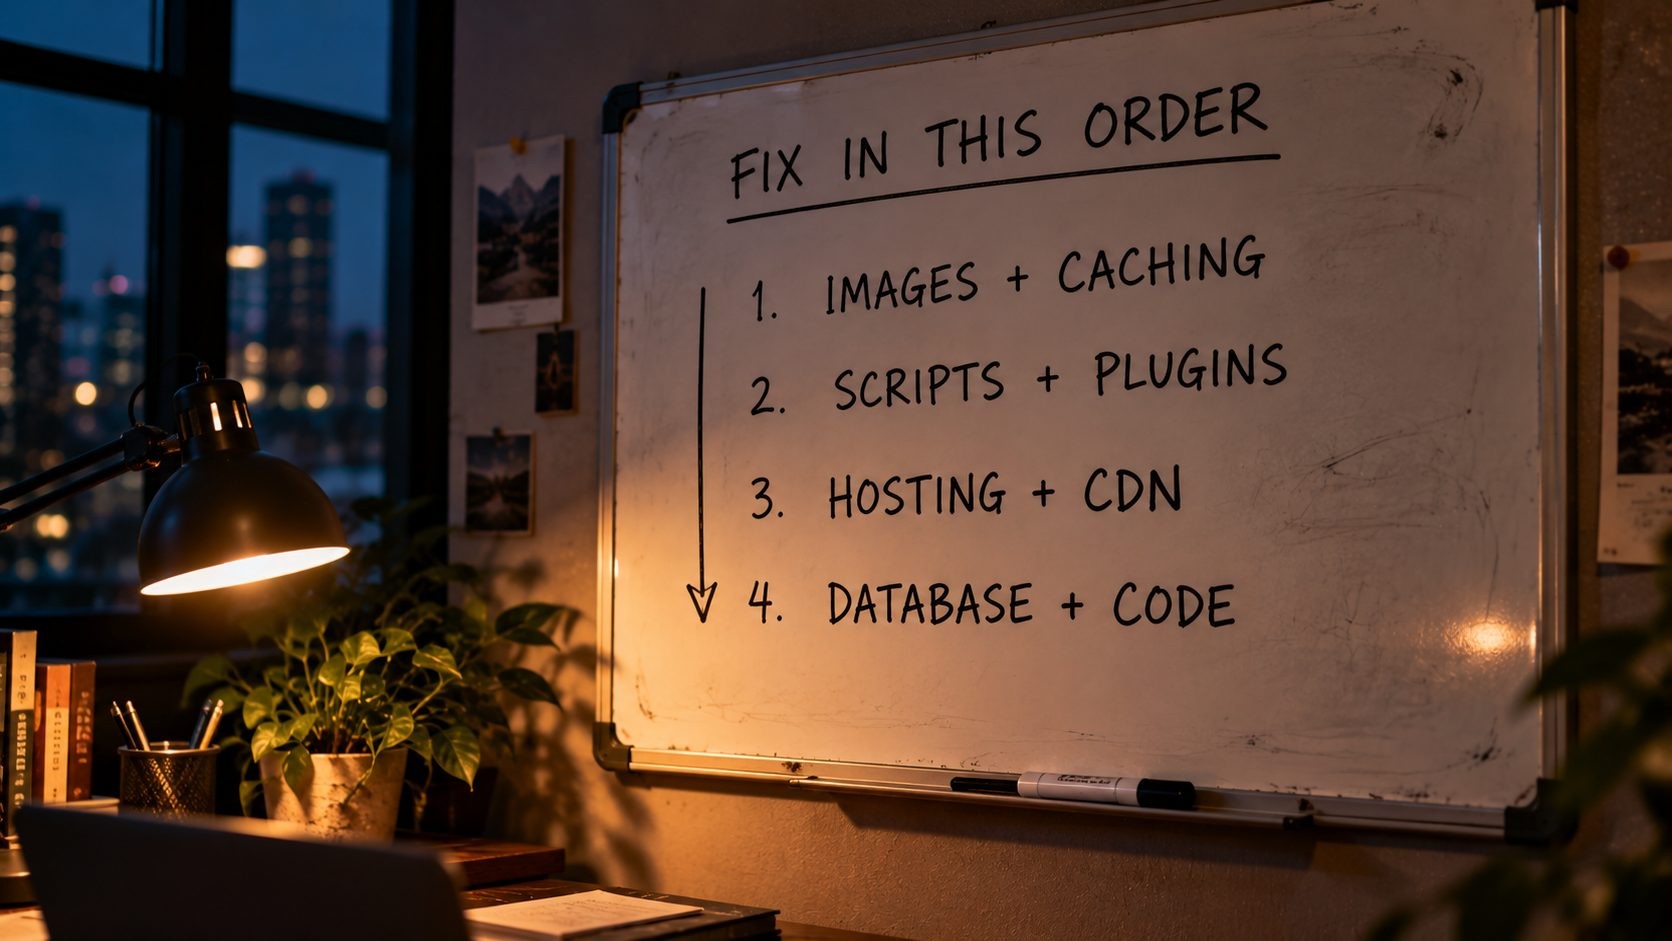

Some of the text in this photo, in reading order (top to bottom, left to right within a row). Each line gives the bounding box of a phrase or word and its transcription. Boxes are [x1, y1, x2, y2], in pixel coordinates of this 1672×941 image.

[730, 81, 1269, 200] FIX IN THIS ORDER
[751, 234, 1266, 322] 1. IMAGES + CACHING
[750, 342, 1288, 416] 2. SCRIPTS + PLUGINS
[751, 463, 1182, 520] 3. HOSTING + CDN
[748, 580, 1236, 629] 4. DATABASE + CODE
